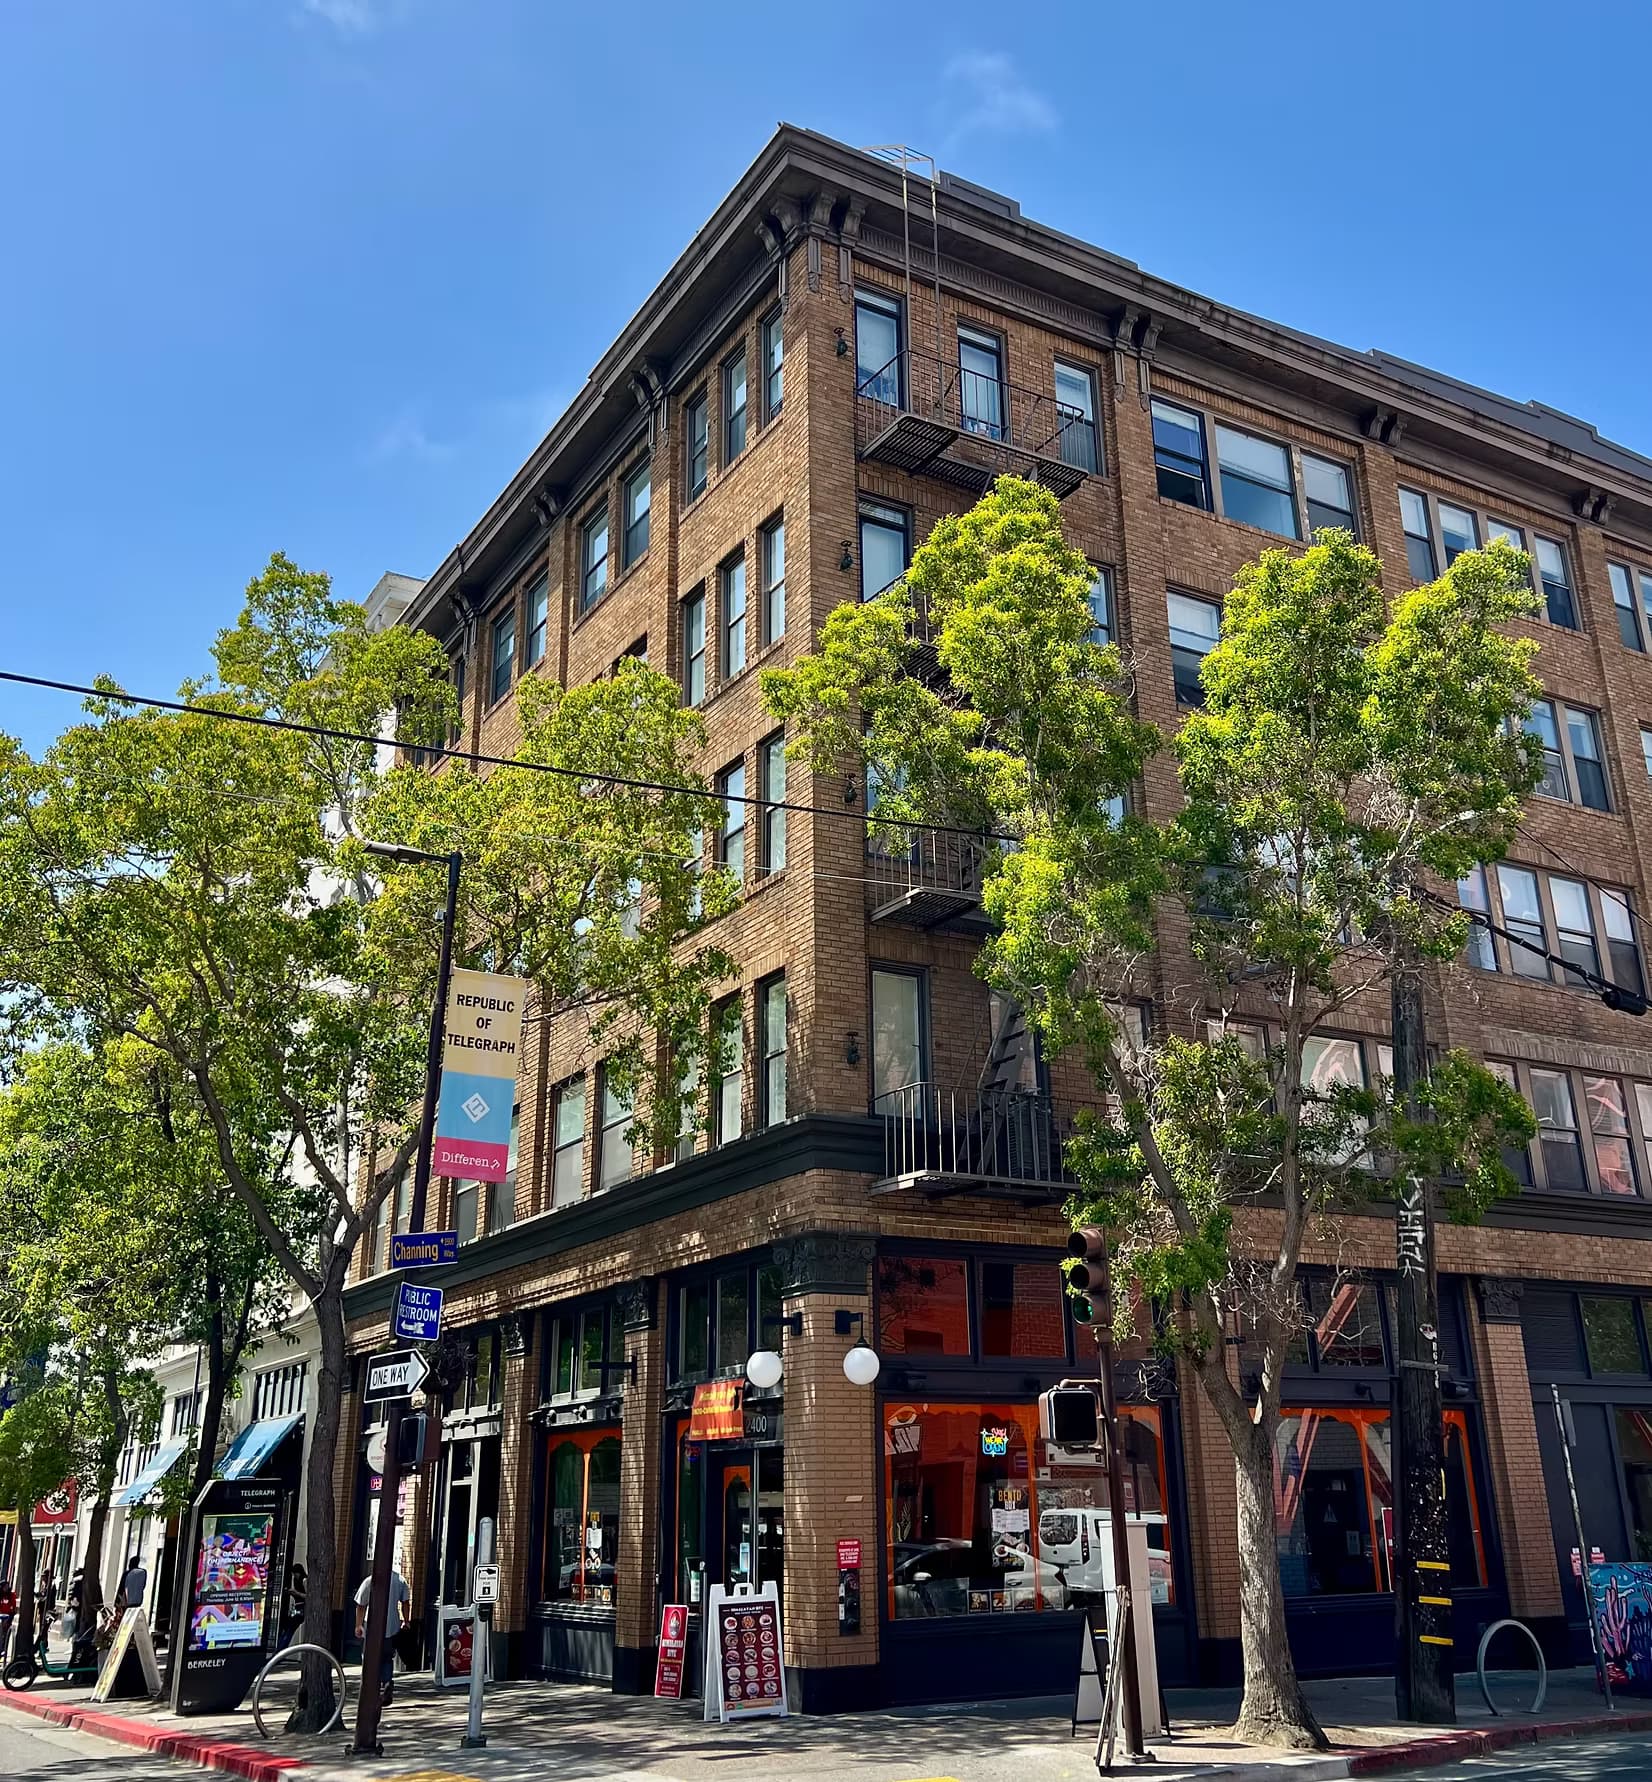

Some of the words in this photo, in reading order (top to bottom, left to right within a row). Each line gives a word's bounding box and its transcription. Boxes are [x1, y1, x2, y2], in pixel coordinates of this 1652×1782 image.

[456, 993, 515, 1014] REPUBLIC
[476, 1016, 492, 1030] OF
[447, 1032, 516, 1054] TELEGRAPH
[394, 1240, 439, 1262] Channing
[404, 1288, 432, 1306] PUBLIC
[399, 1303, 438, 1322] RESTROOM
[372, 1368, 388, 1387] ONE
[390, 1364, 410, 1384] WAY
[745, 1415, 767, 1433] 2400
[985, 1443, 1004, 1452] OPEN
[240, 1489, 276, 1497] TELEGRAPH
[998, 1489, 1022, 1502] BENTO
[187, 1658, 227, 1670] BERKELEY
